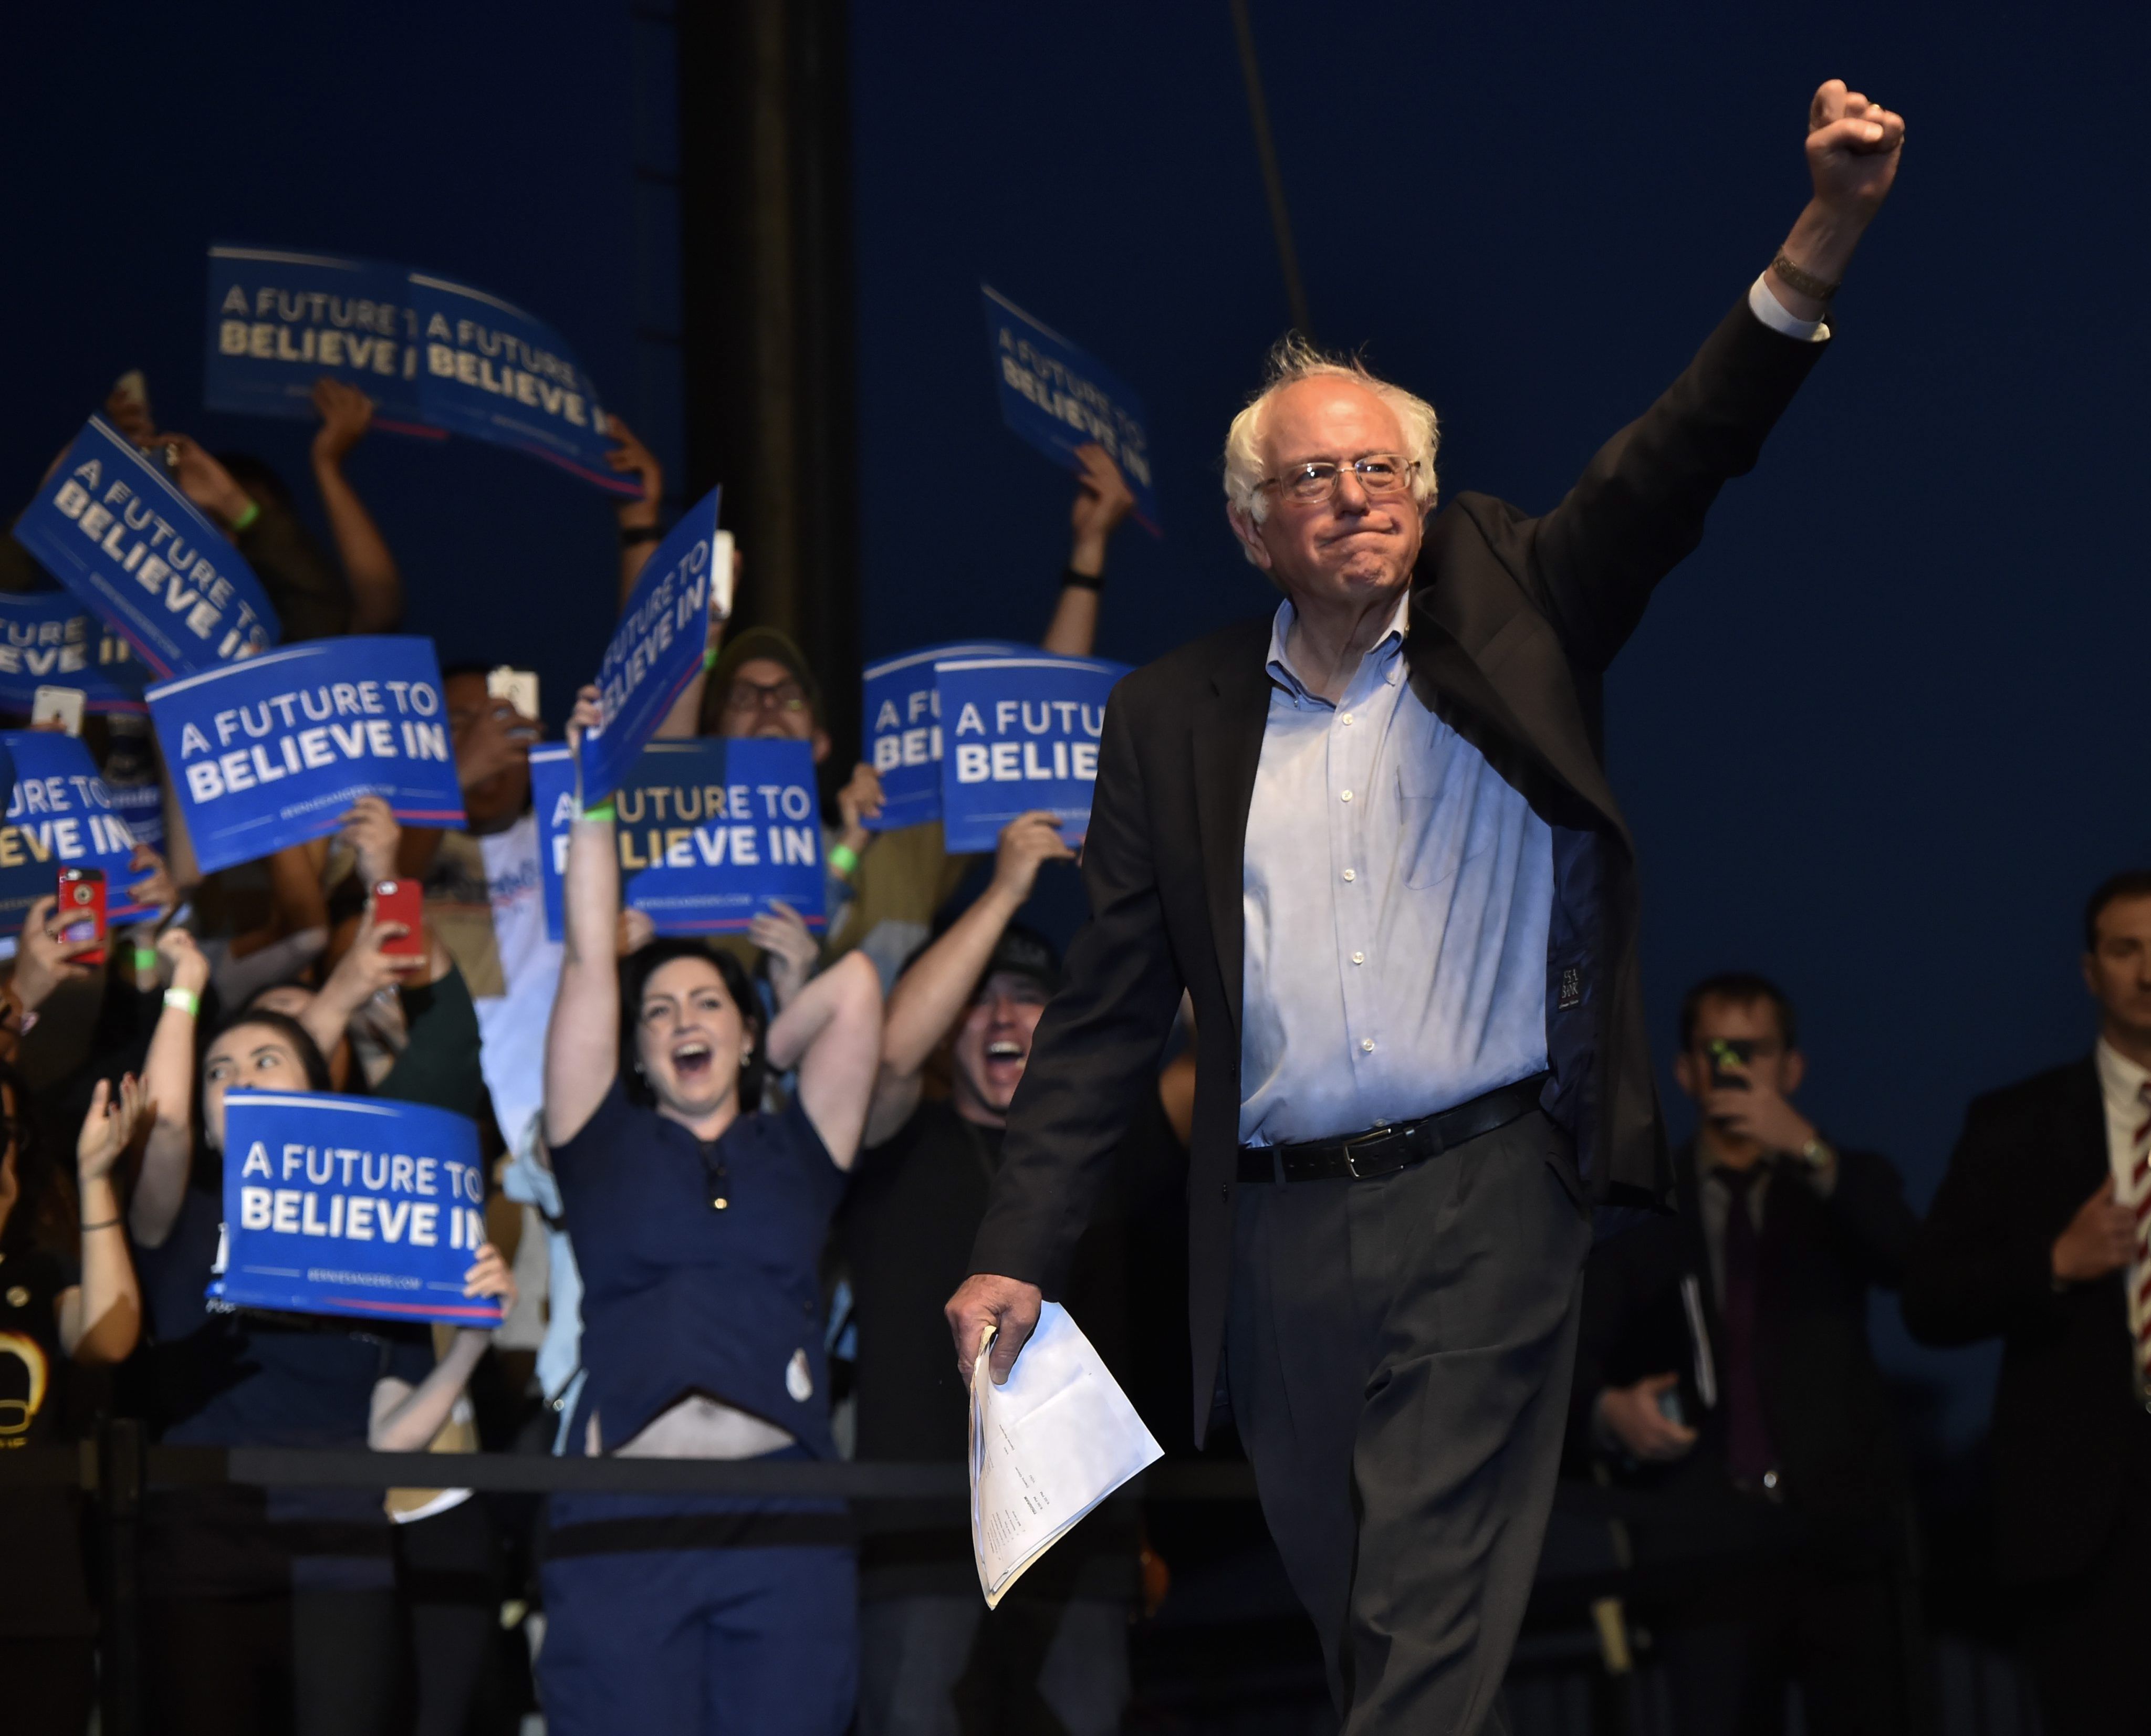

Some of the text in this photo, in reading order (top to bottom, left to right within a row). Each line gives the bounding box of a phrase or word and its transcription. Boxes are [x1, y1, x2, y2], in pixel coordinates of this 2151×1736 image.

[223, 285, 249, 316] A
[256, 287, 396, 332] FUTURE
[427, 313, 452, 341] A
[220, 320, 396, 375] BELIEVE
[427, 342, 588, 426] BELIEVE
[53, 478, 222, 640] BELIEVE
[74, 458, 102, 490] A
[105, 479, 235, 610] FUTURE
[603, 540, 709, 678] FUTURE TO
[677, 575, 705, 631] IN
[181, 681, 439, 759] A FUTURE TO
[874, 699, 900, 733] A
[956, 702, 986, 736] A
[185, 720, 398, 804] BELIEVE
[401, 720, 449, 762] IN
[956, 741, 1100, 783] BELIE
[616, 786, 753, 823] UTURE
[756, 785, 811, 821] TO
[767, 825, 816, 867] IN
[242, 1141, 484, 1204] A FUTURE TO
[241, 1185, 440, 1248] BELIEVE
